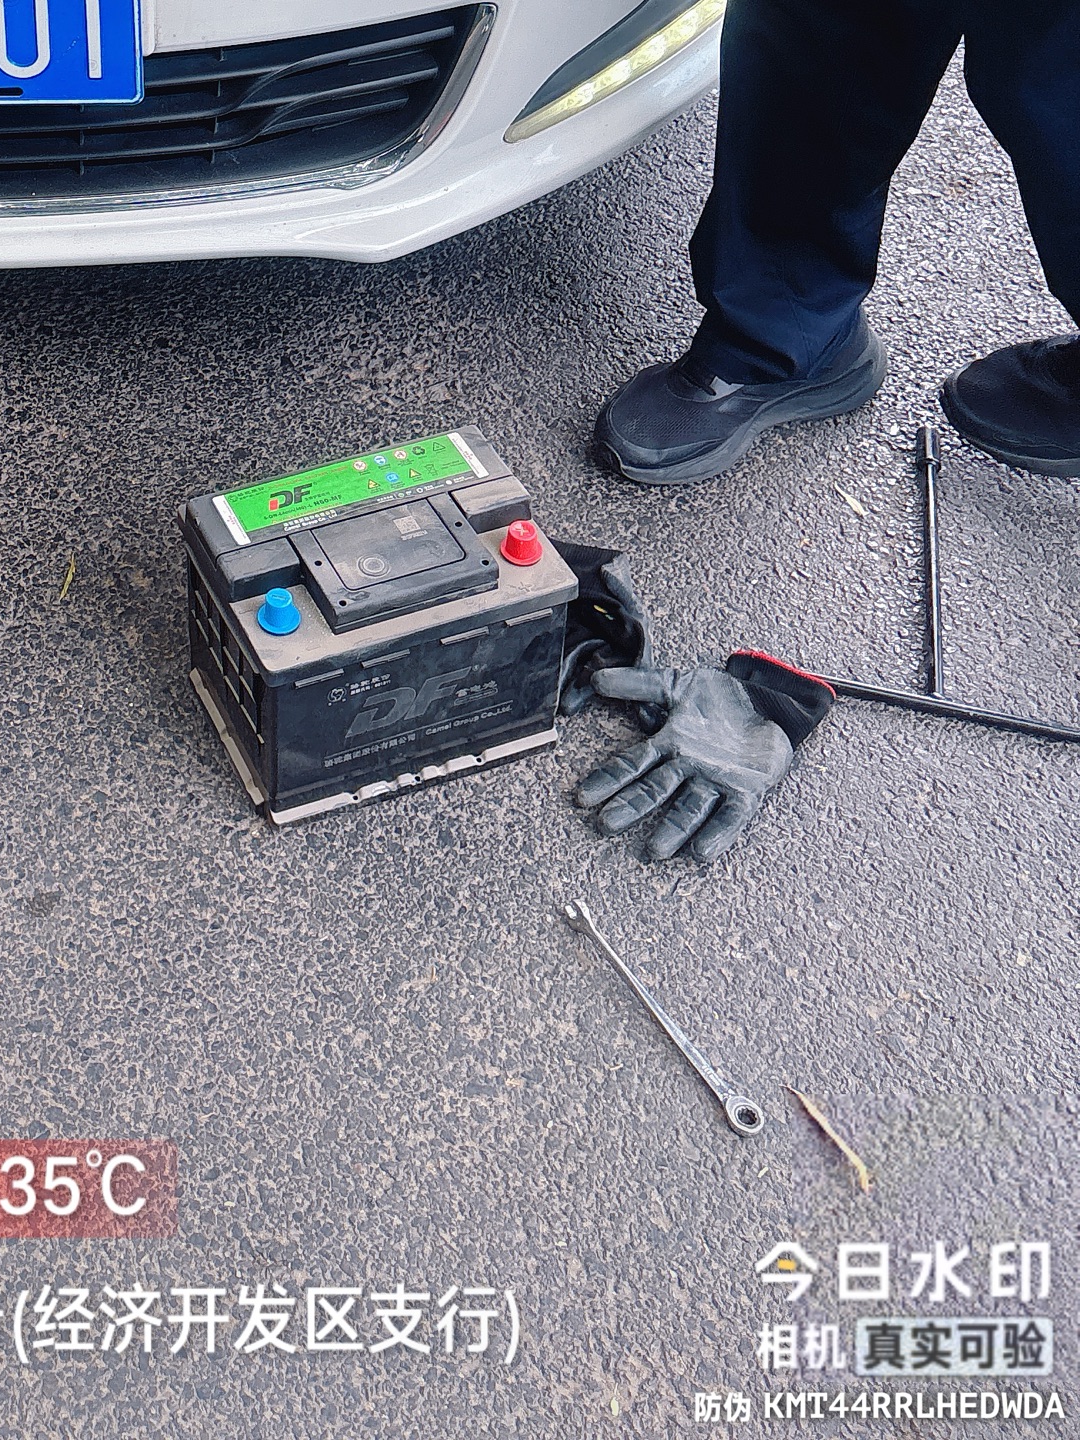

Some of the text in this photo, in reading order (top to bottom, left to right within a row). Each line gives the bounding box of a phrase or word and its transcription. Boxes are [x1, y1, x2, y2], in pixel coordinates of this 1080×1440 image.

[269, 482, 313, 511] DF
[345, 666, 472, 738] DF
[425, 721, 452, 736] Camel
[453, 715, 481, 728] Group
